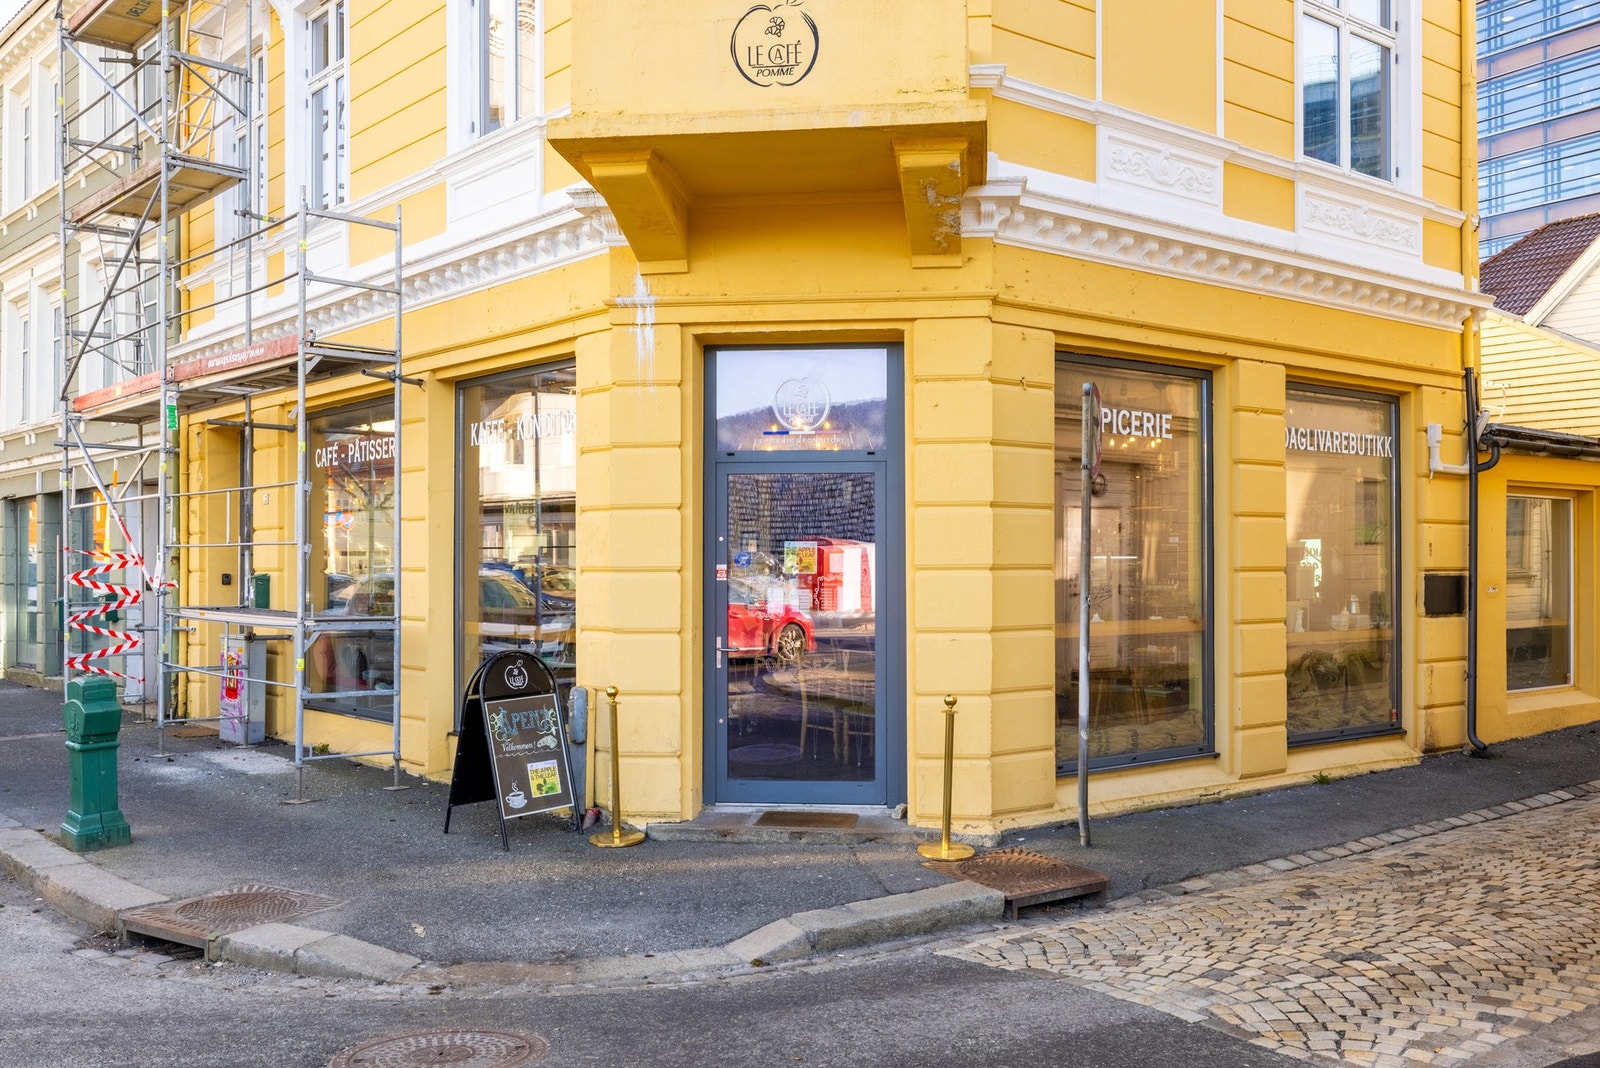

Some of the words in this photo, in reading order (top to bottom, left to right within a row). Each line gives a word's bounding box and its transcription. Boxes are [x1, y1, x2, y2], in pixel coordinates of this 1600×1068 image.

[748, 45, 764, 66] LE
[768, 40, 802, 65] CAFÉ
[756, 67, 795, 77] POMME
[315, 443, 339, 468] CAFÉ
